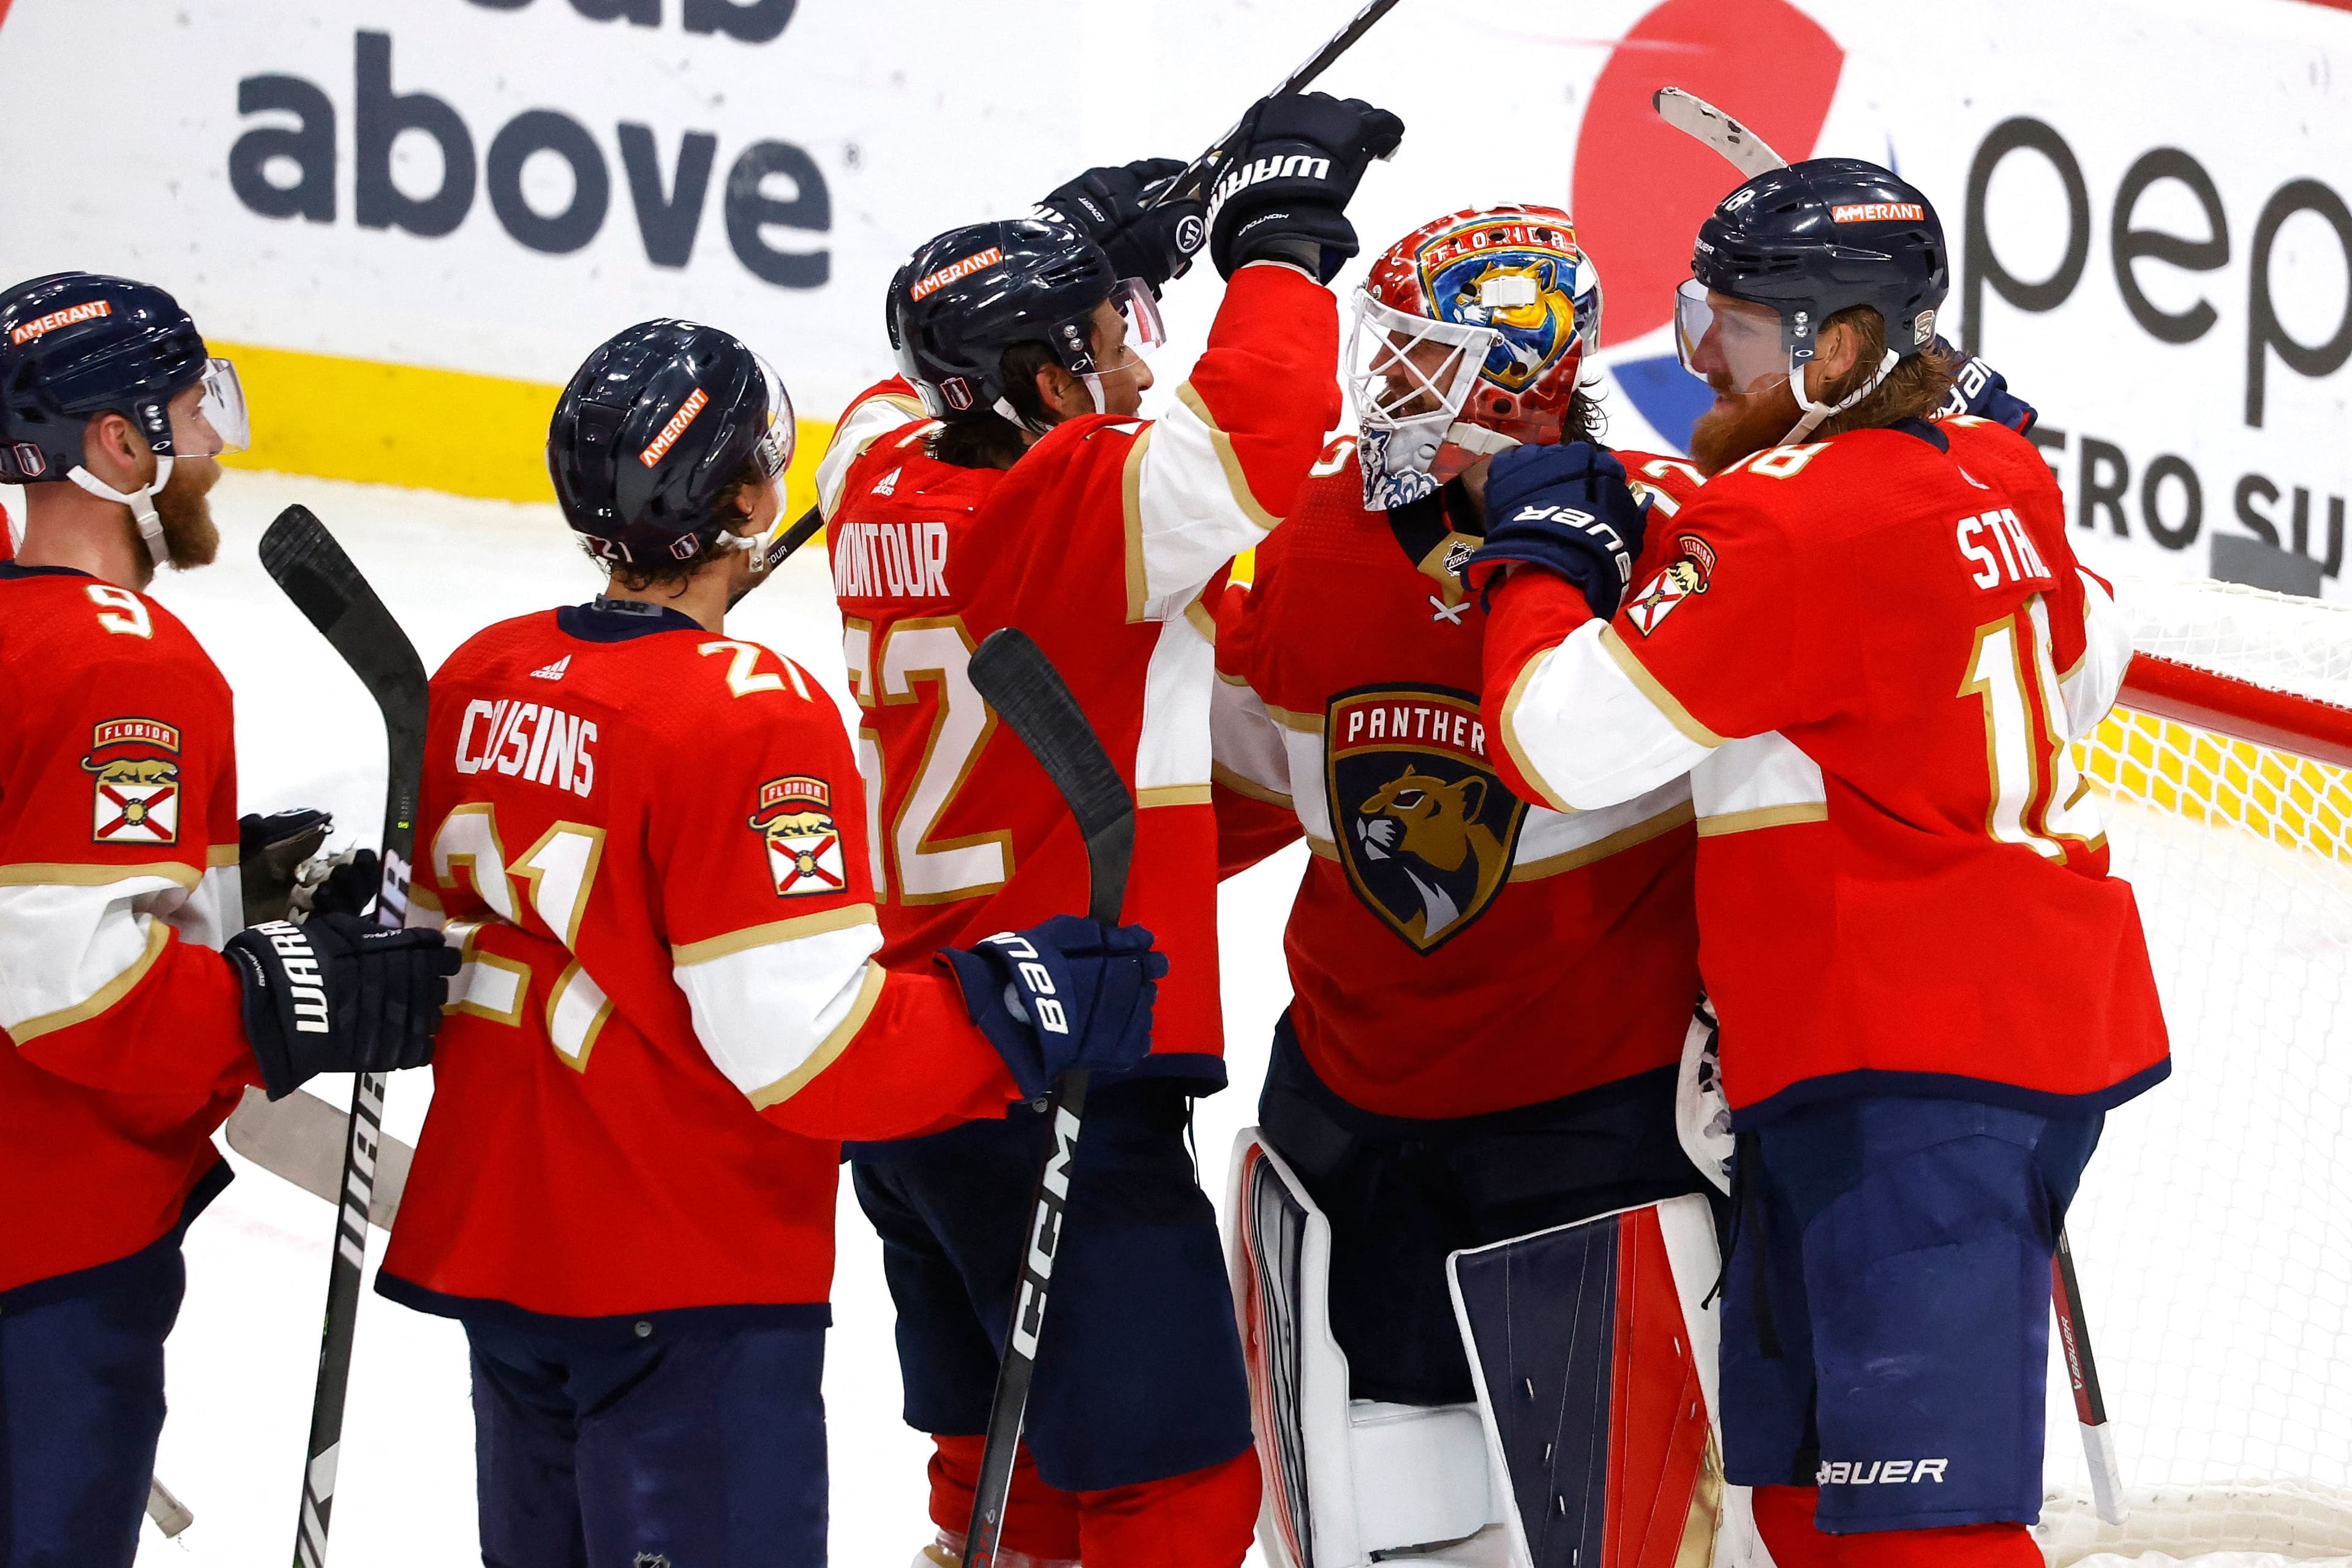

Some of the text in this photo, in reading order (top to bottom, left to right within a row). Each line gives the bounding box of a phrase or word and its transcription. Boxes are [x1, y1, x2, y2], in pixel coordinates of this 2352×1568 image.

[228, 29, 832, 292] above
[1078, 197, 1105, 222] COVERT
[1238, 213, 1289, 236] MONTOUR
[1835, 204, 1922, 222] AMERANT
[912, 248, 1001, 301] AMERANT
[12, 300, 108, 344] AMERANT
[642, 389, 709, 466] AMERANT
[834, 522, 950, 597] MONTOUR
[1448, 553, 1469, 567] NHL
[1684, 540, 1711, 567] FLORIDA
[85, 584, 154, 639] 9
[104, 723, 171, 744] FLORIDA
[768, 783, 822, 799] FLORIDA
[1012, 1104, 1082, 1362] CCM
[2060, 1315, 2084, 1379] BAUER
